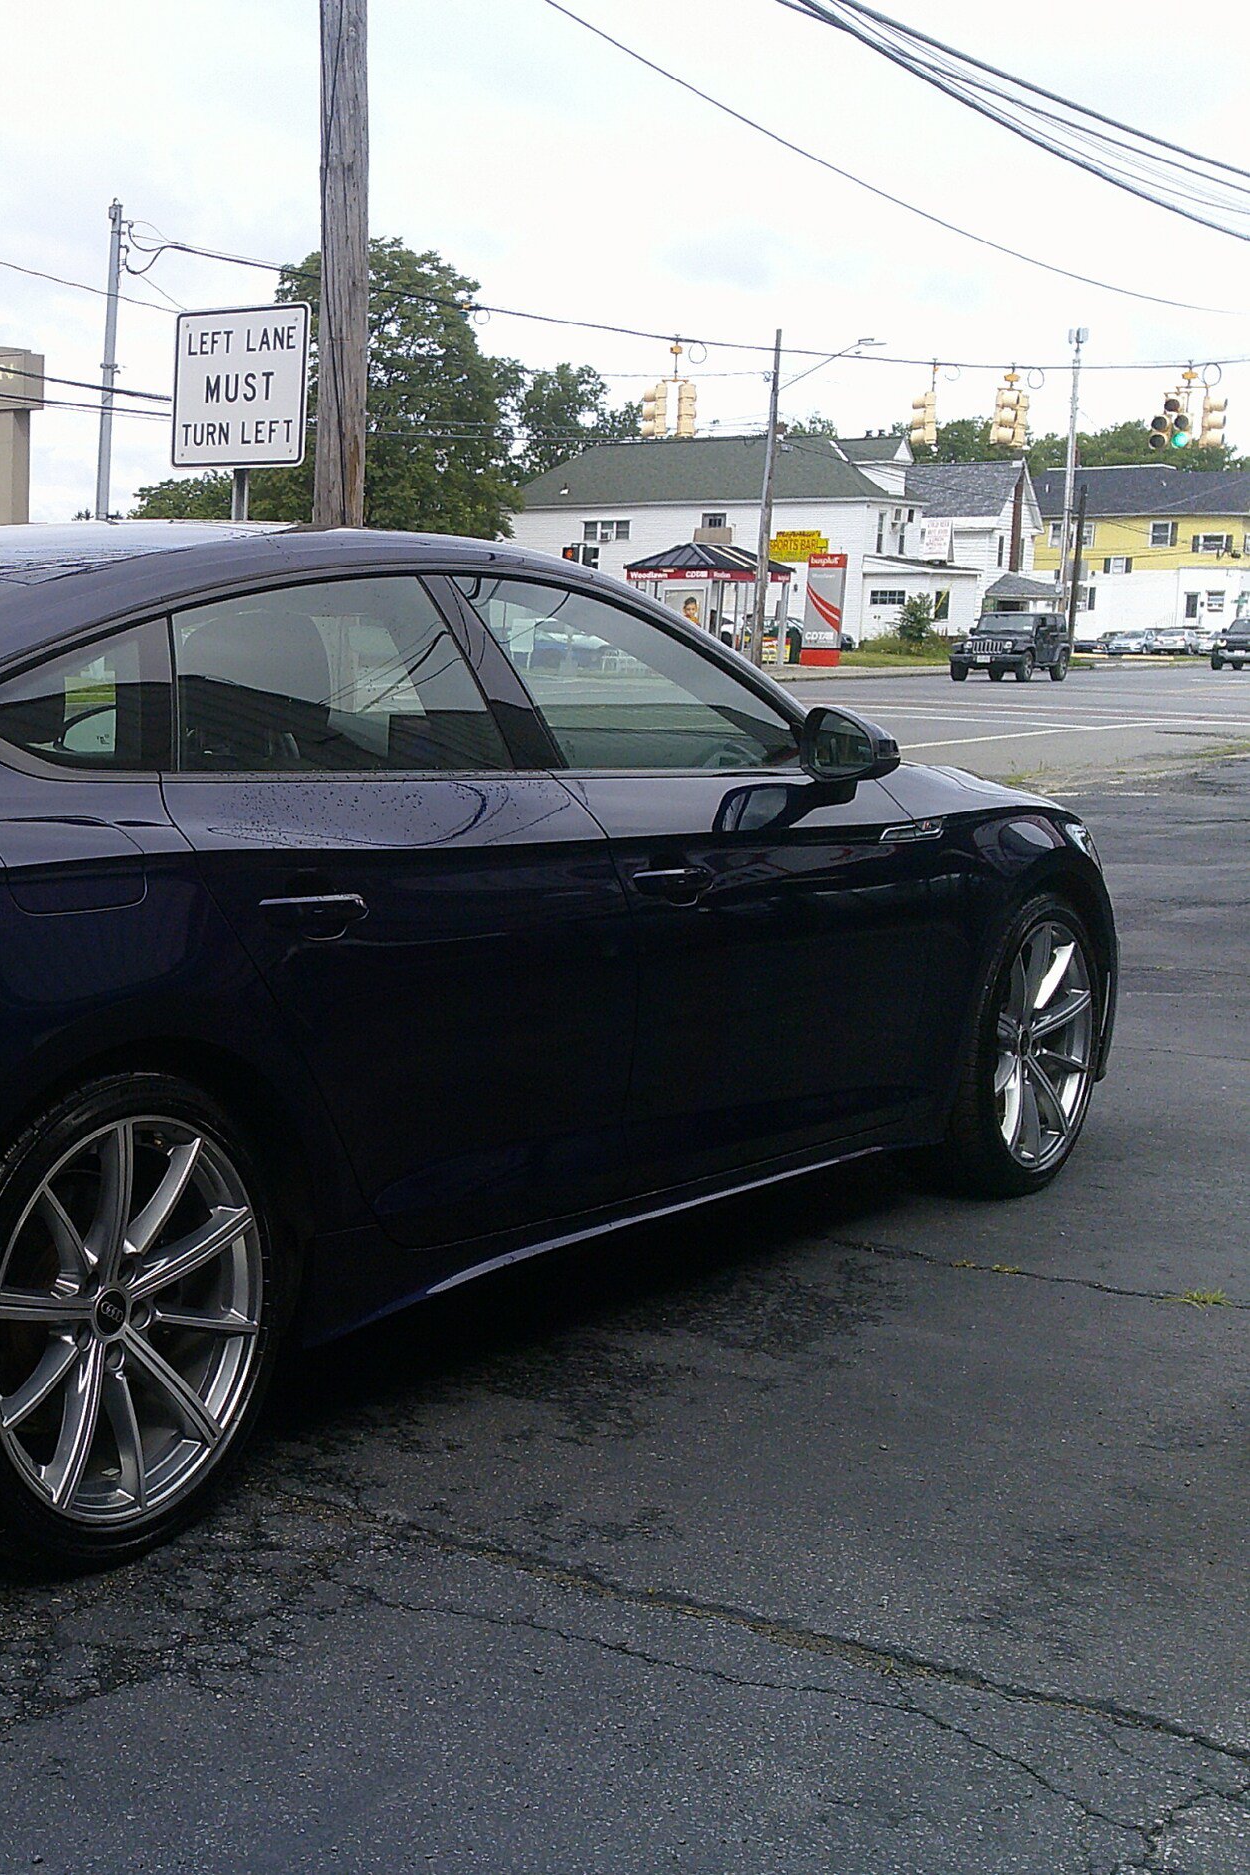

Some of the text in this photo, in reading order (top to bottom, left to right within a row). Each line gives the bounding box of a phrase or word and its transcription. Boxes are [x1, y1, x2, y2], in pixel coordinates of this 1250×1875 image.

[187, 325, 298, 356] LEFT LANE
[204, 371, 275, 404] MUST
[181, 418, 294, 447] TURN LEFT
[769, 539, 798, 551] SPORTS
[629, 570, 669, 579] Woodlawn
